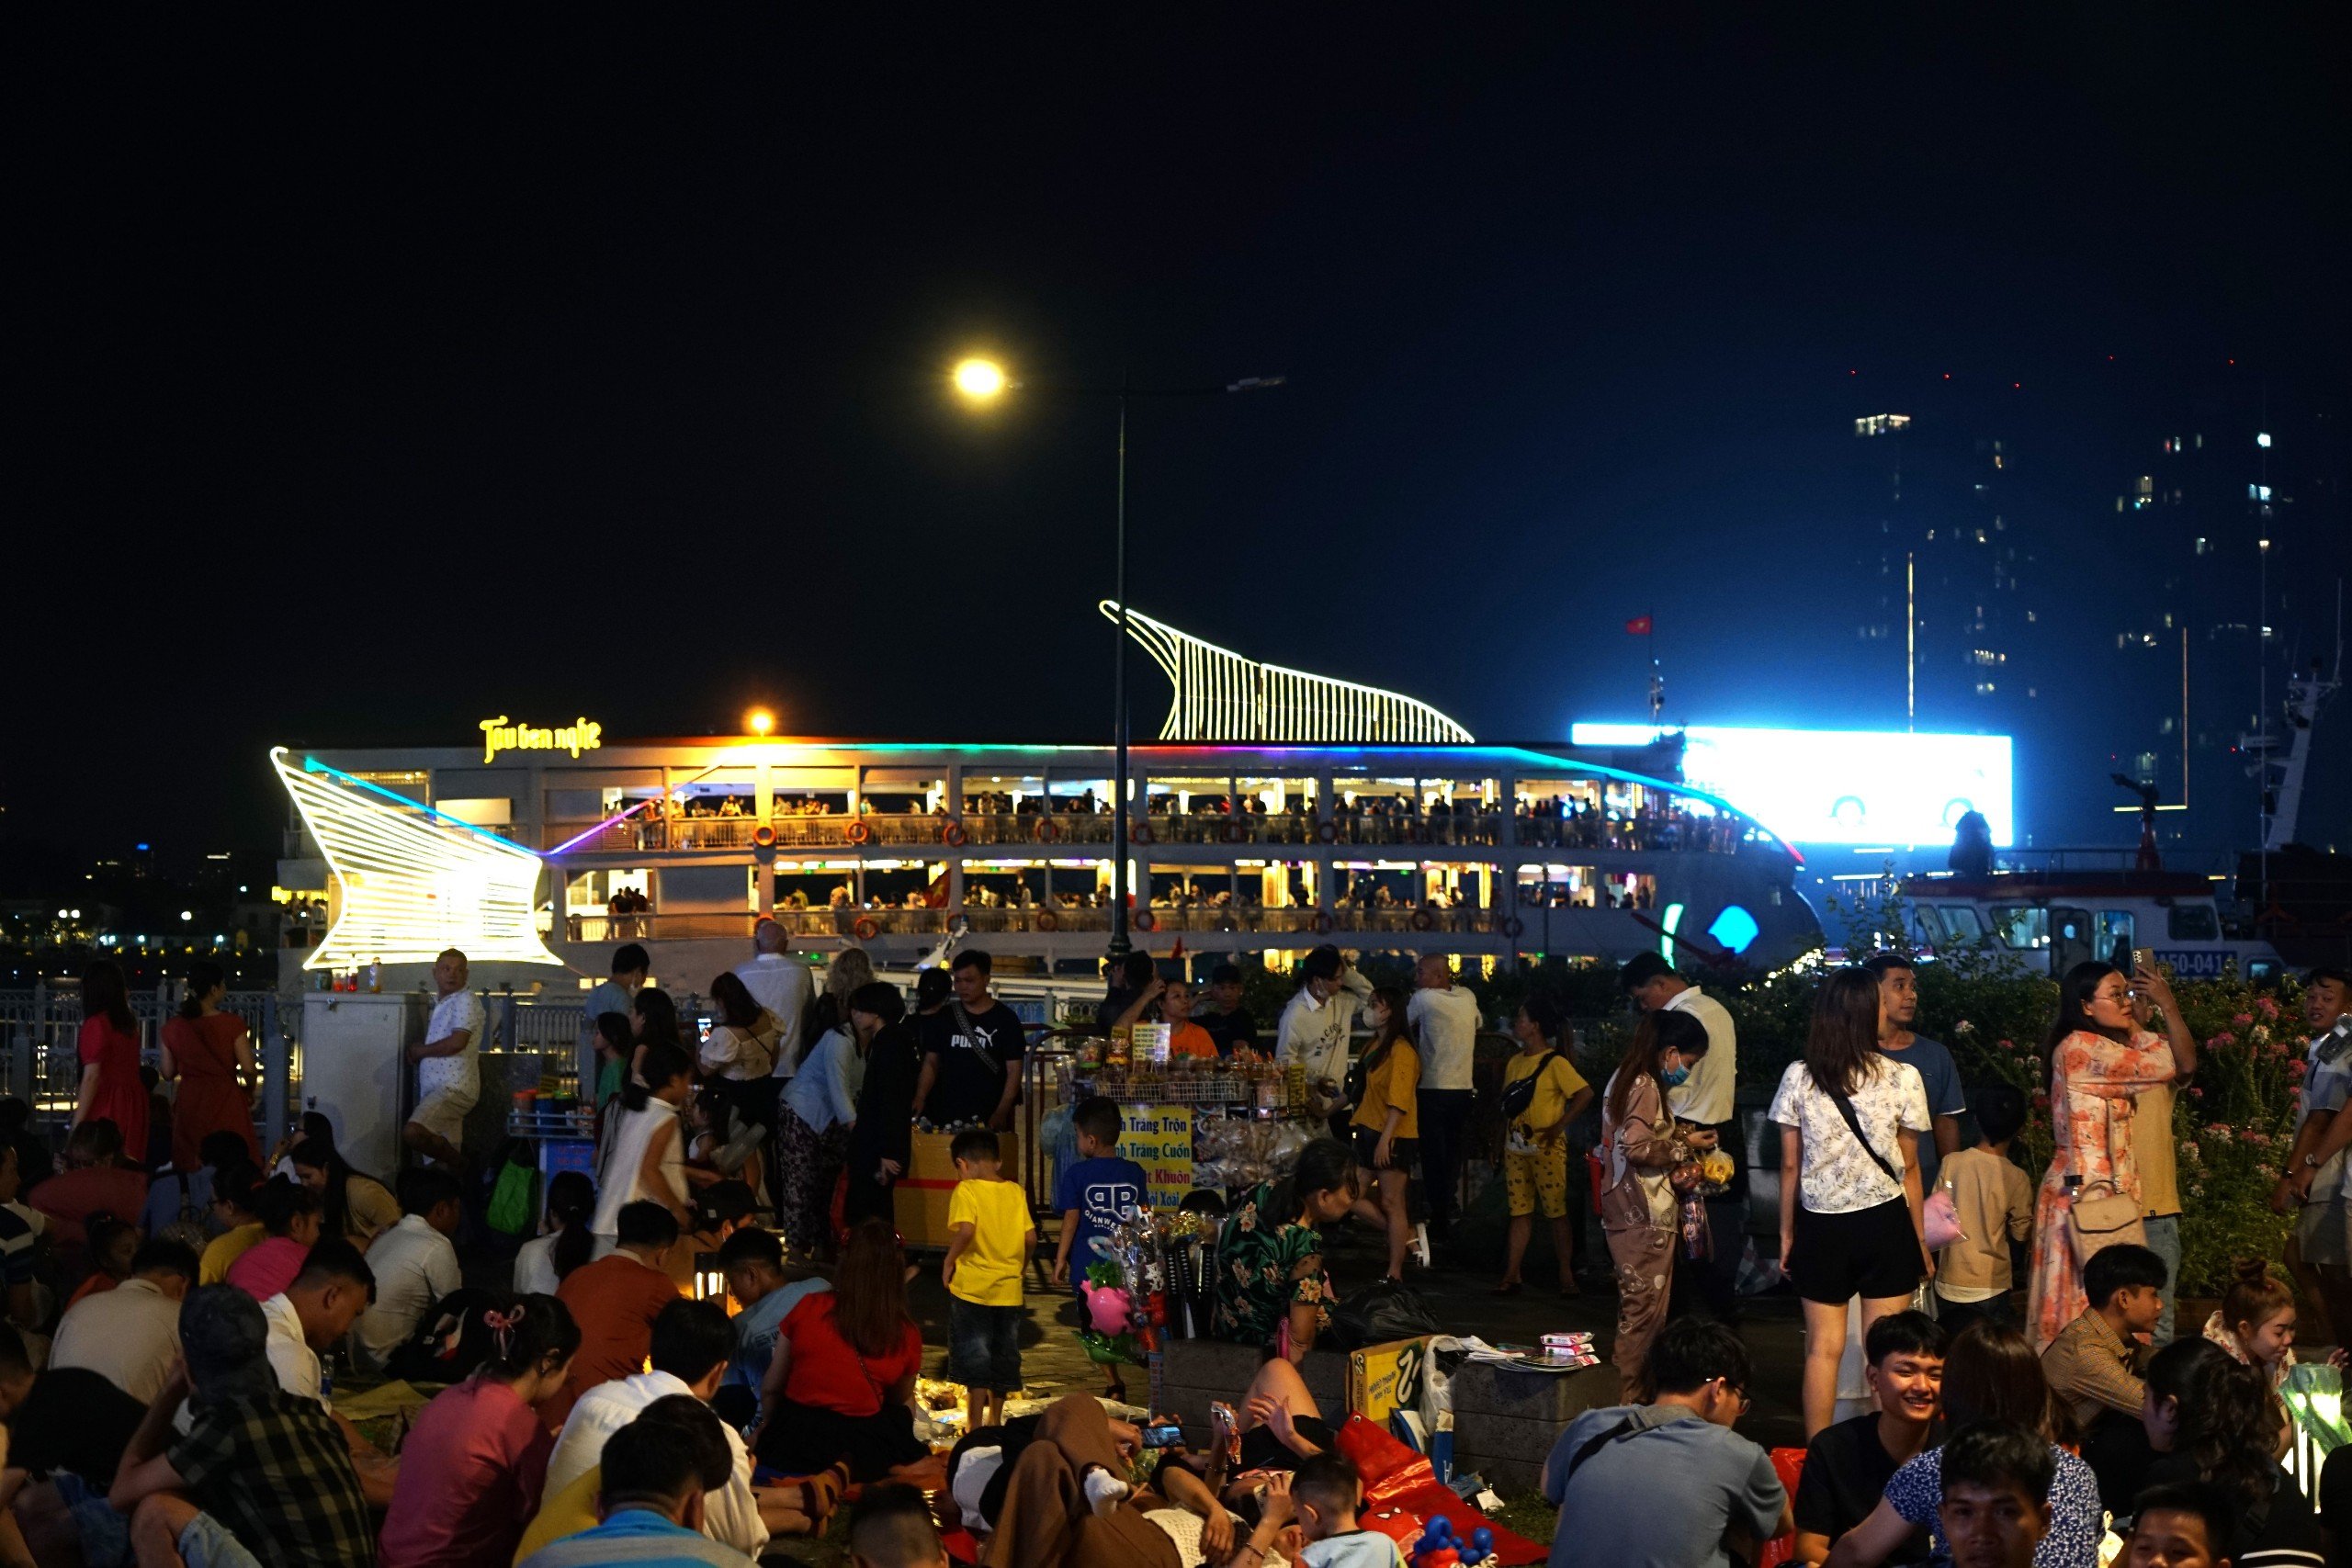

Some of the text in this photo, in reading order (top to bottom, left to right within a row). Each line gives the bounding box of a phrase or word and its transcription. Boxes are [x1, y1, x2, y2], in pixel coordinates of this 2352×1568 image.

[951, 1034, 987, 1049] PUA
[1162, 1117, 1187, 1134] Trộn
[1162, 1142, 1191, 1157] Cuốn
[1084, 1209, 1117, 1229] QIANWE
